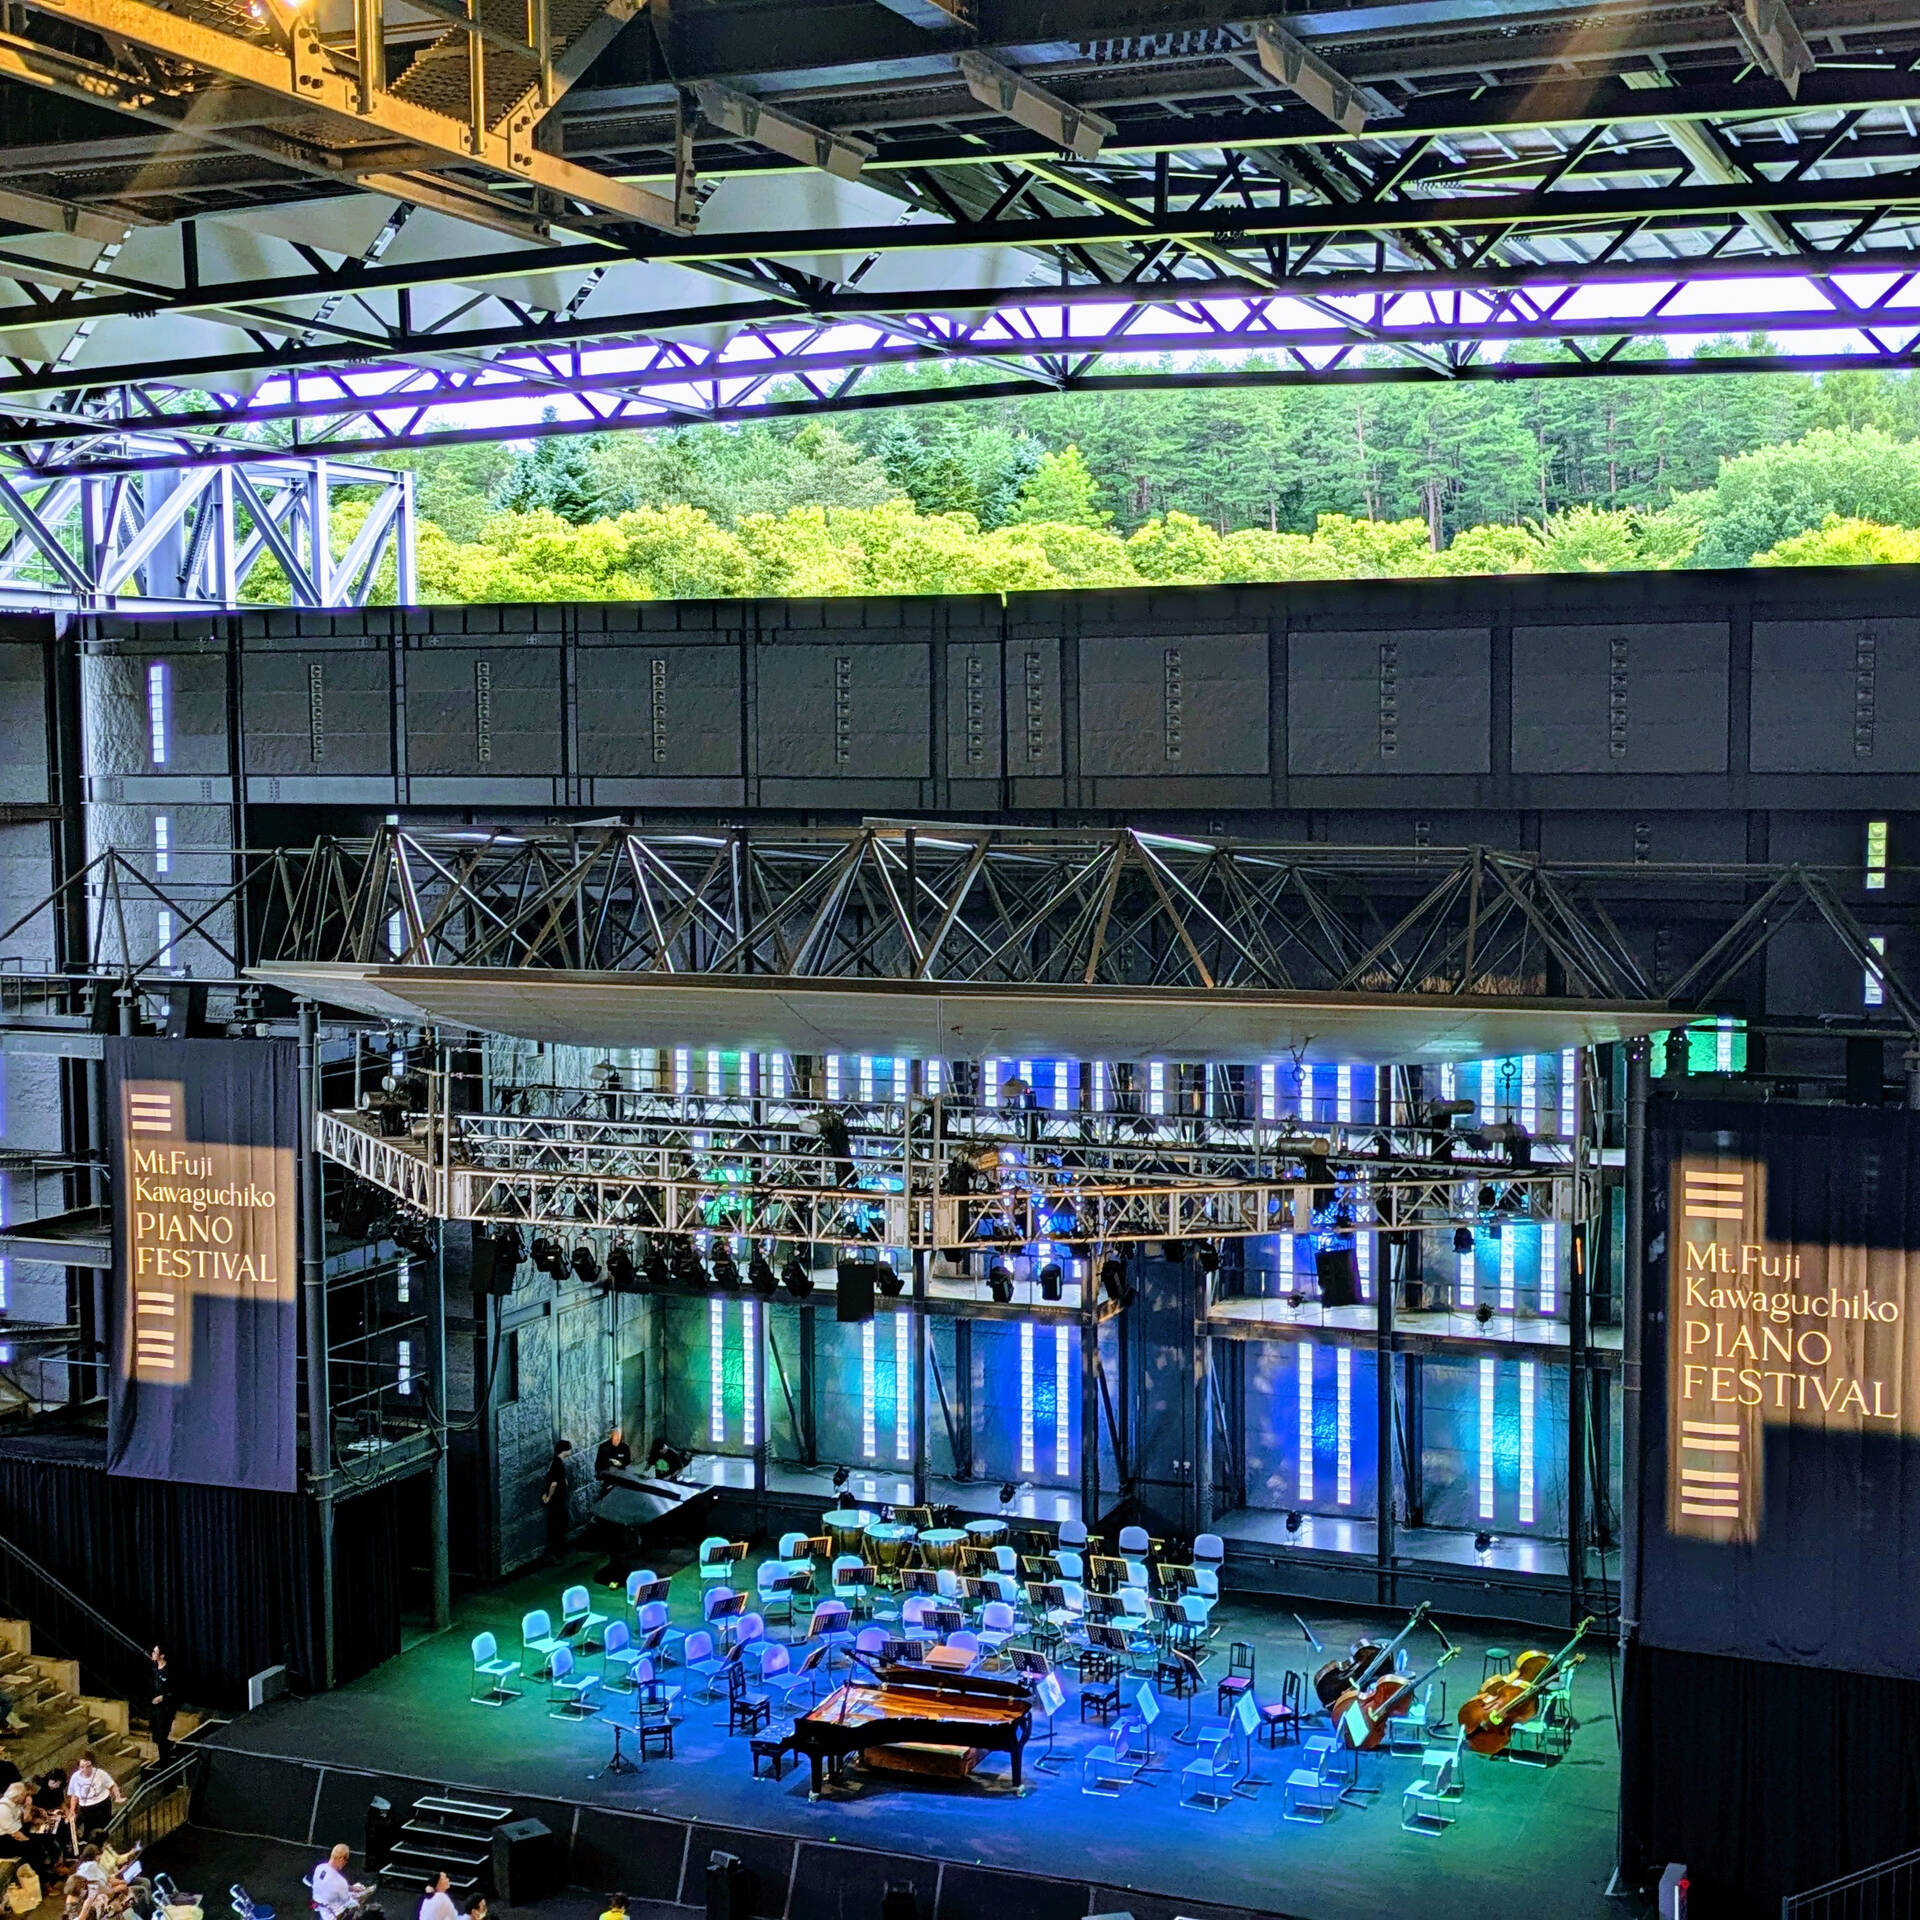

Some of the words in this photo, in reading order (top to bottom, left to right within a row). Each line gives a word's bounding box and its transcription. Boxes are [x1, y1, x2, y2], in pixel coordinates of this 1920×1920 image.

[134, 1149, 212, 1180] Mt.Fuji
[135, 1177, 275, 1212] Kawaguchiko
[136, 1212, 233, 1244] PIANO
[137, 1247, 277, 1282] FESTIVAL
[1686, 1240, 1801, 1283] Mt.Fuji
[1685, 1277, 1899, 1323] Kawaguchiko
[1684, 1320, 1832, 1366] PIANO
[1683, 1365, 1899, 1419] FESTIVAL
